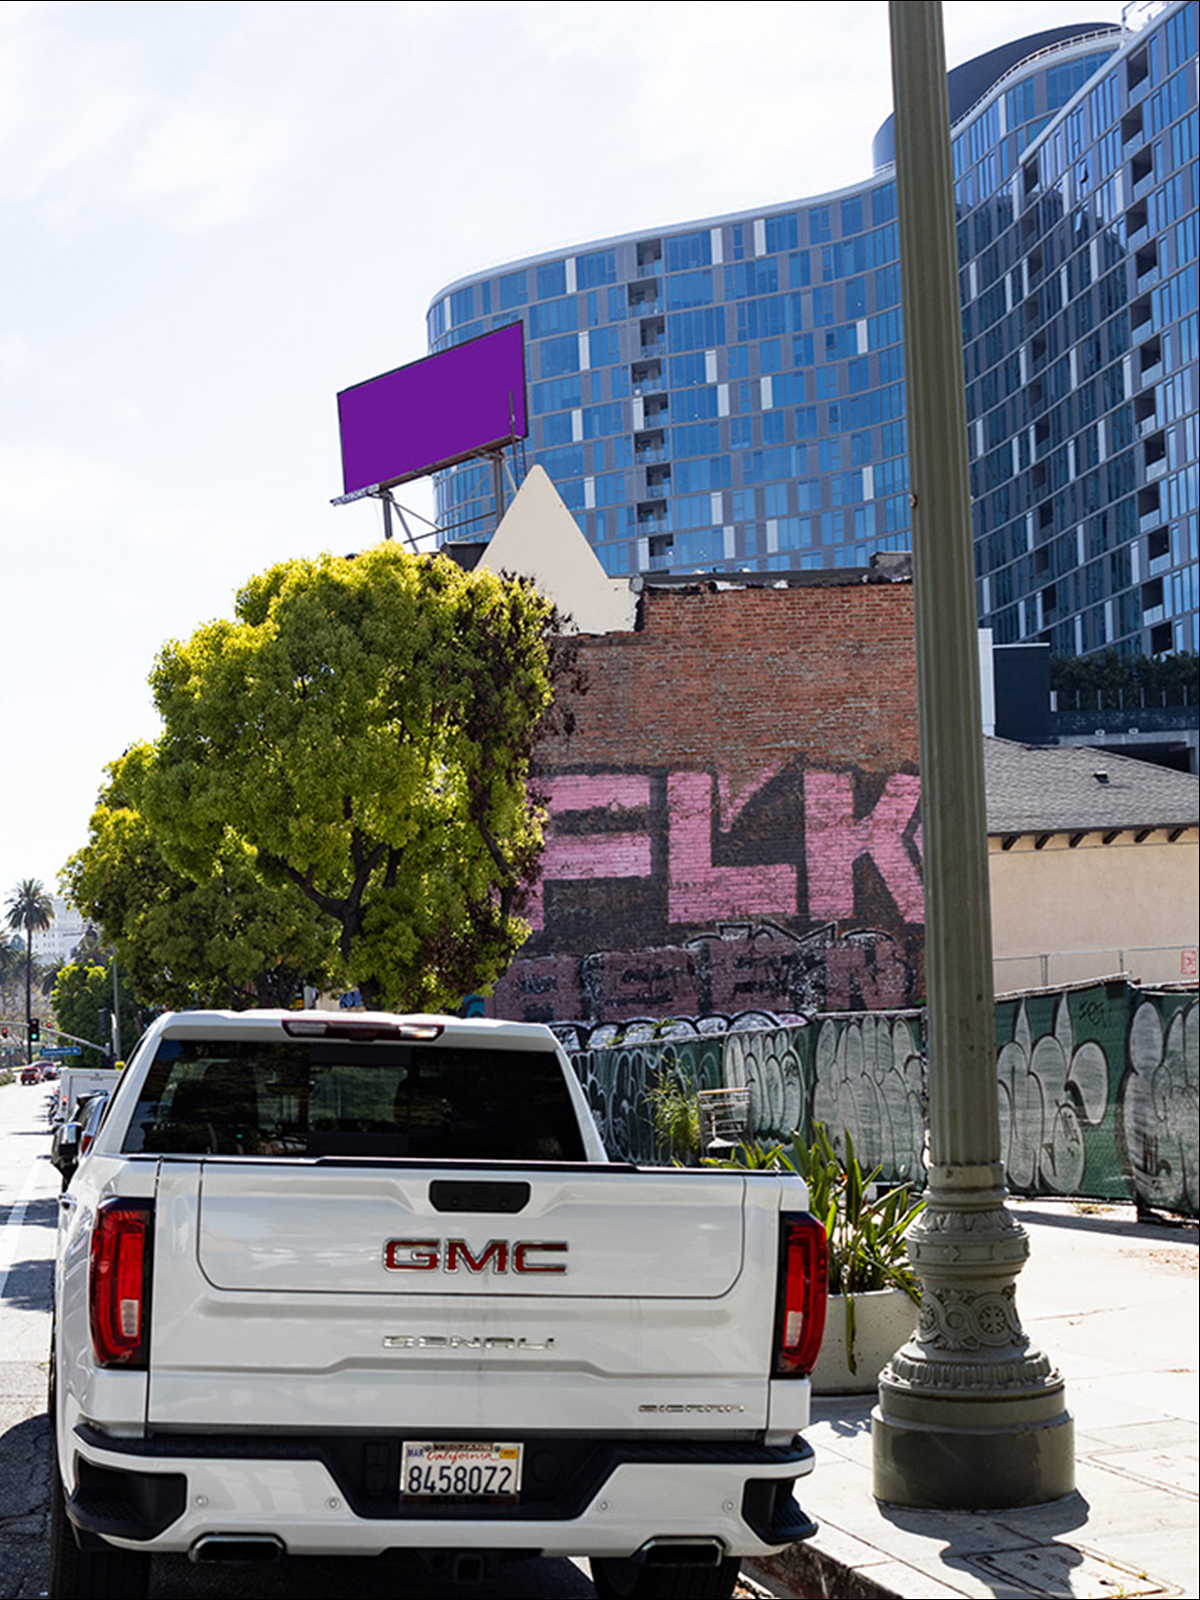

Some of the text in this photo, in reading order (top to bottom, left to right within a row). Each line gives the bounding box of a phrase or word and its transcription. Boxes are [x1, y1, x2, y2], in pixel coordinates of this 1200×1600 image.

[383, 1237, 569, 1275] GMC
[383, 1335, 554, 1349] DENALI
[638, 1404, 746, 1413] SIERRA
[407, 1448, 425, 1457] MAR
[426, 1450, 500, 1465] California
[408, 1465, 512, 1494] 84580Z2
